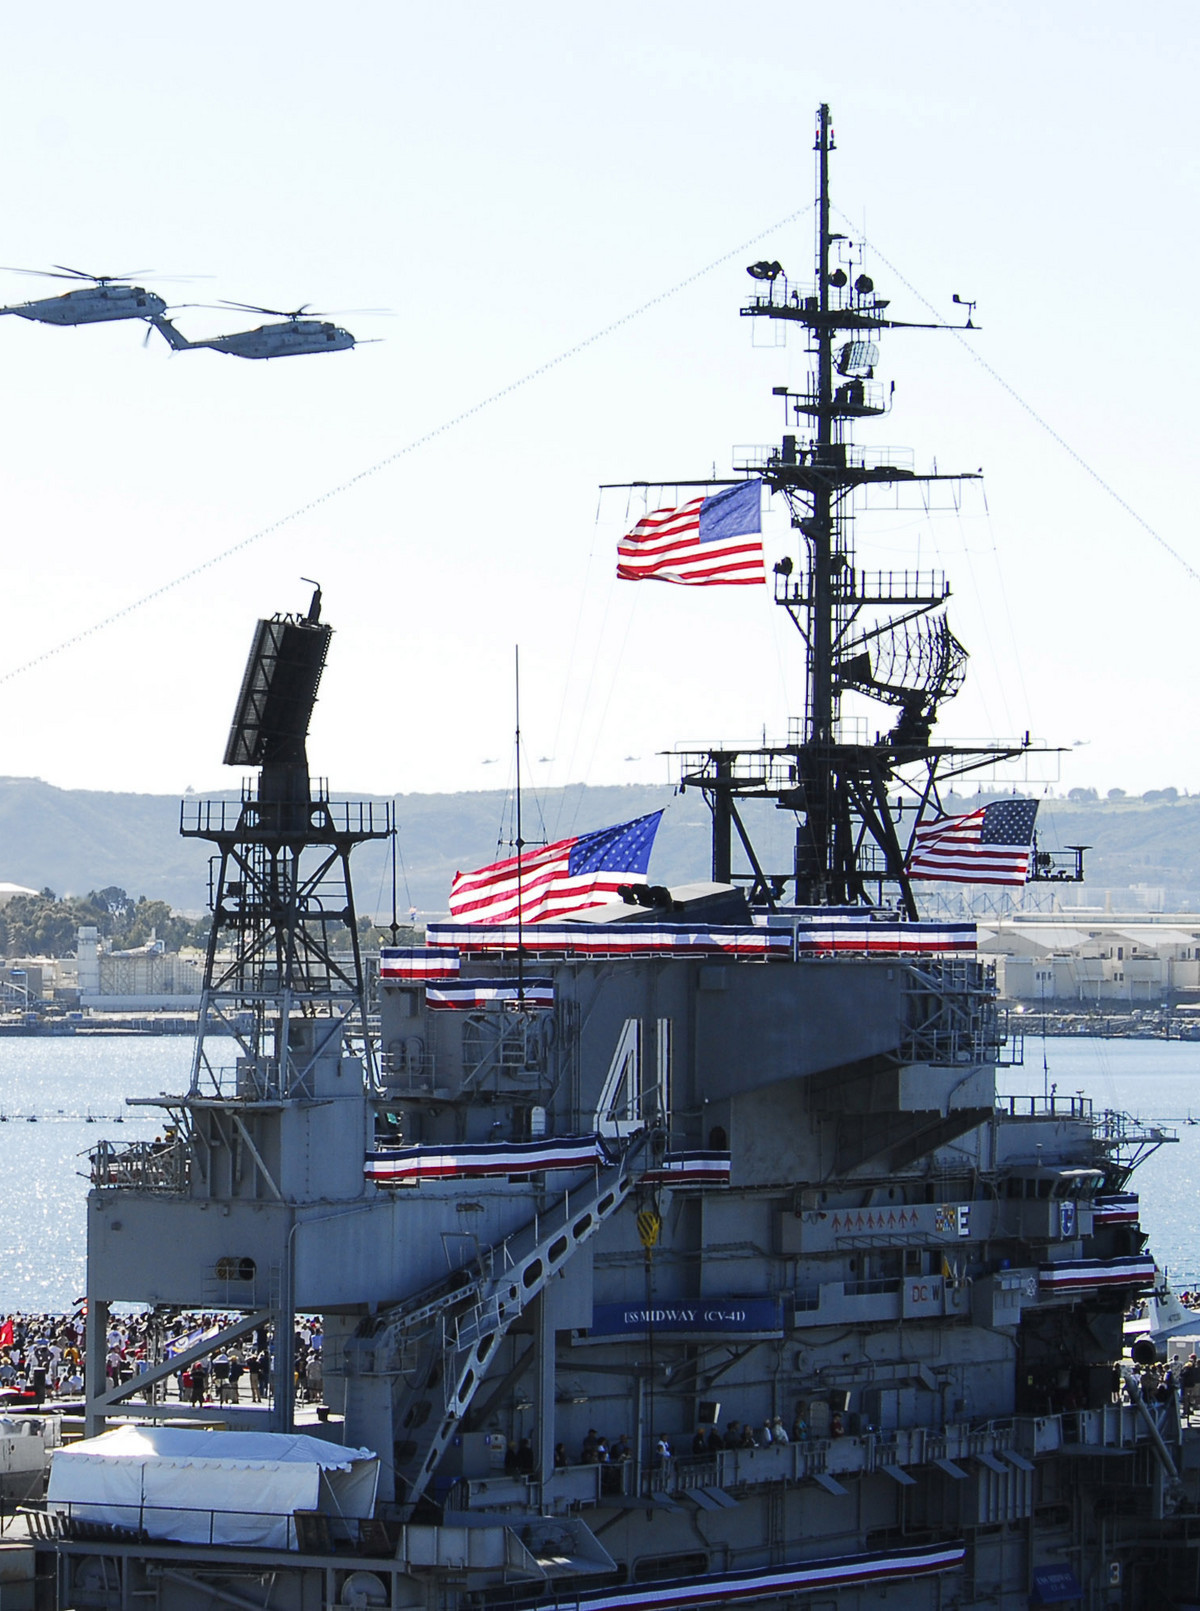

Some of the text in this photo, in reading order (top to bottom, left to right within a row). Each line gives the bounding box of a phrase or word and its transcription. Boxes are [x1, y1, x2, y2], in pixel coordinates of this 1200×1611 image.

[593, 1018, 672, 1153] 41
[958, 1205, 971, 1237] E
[912, 1285, 940, 1302] DC W
[952, 1288, 960, 1308] C
[624, 1310, 746, 1323] USS MIDWAY (CV-41)
[1110, 1562, 1120, 1584] 3
